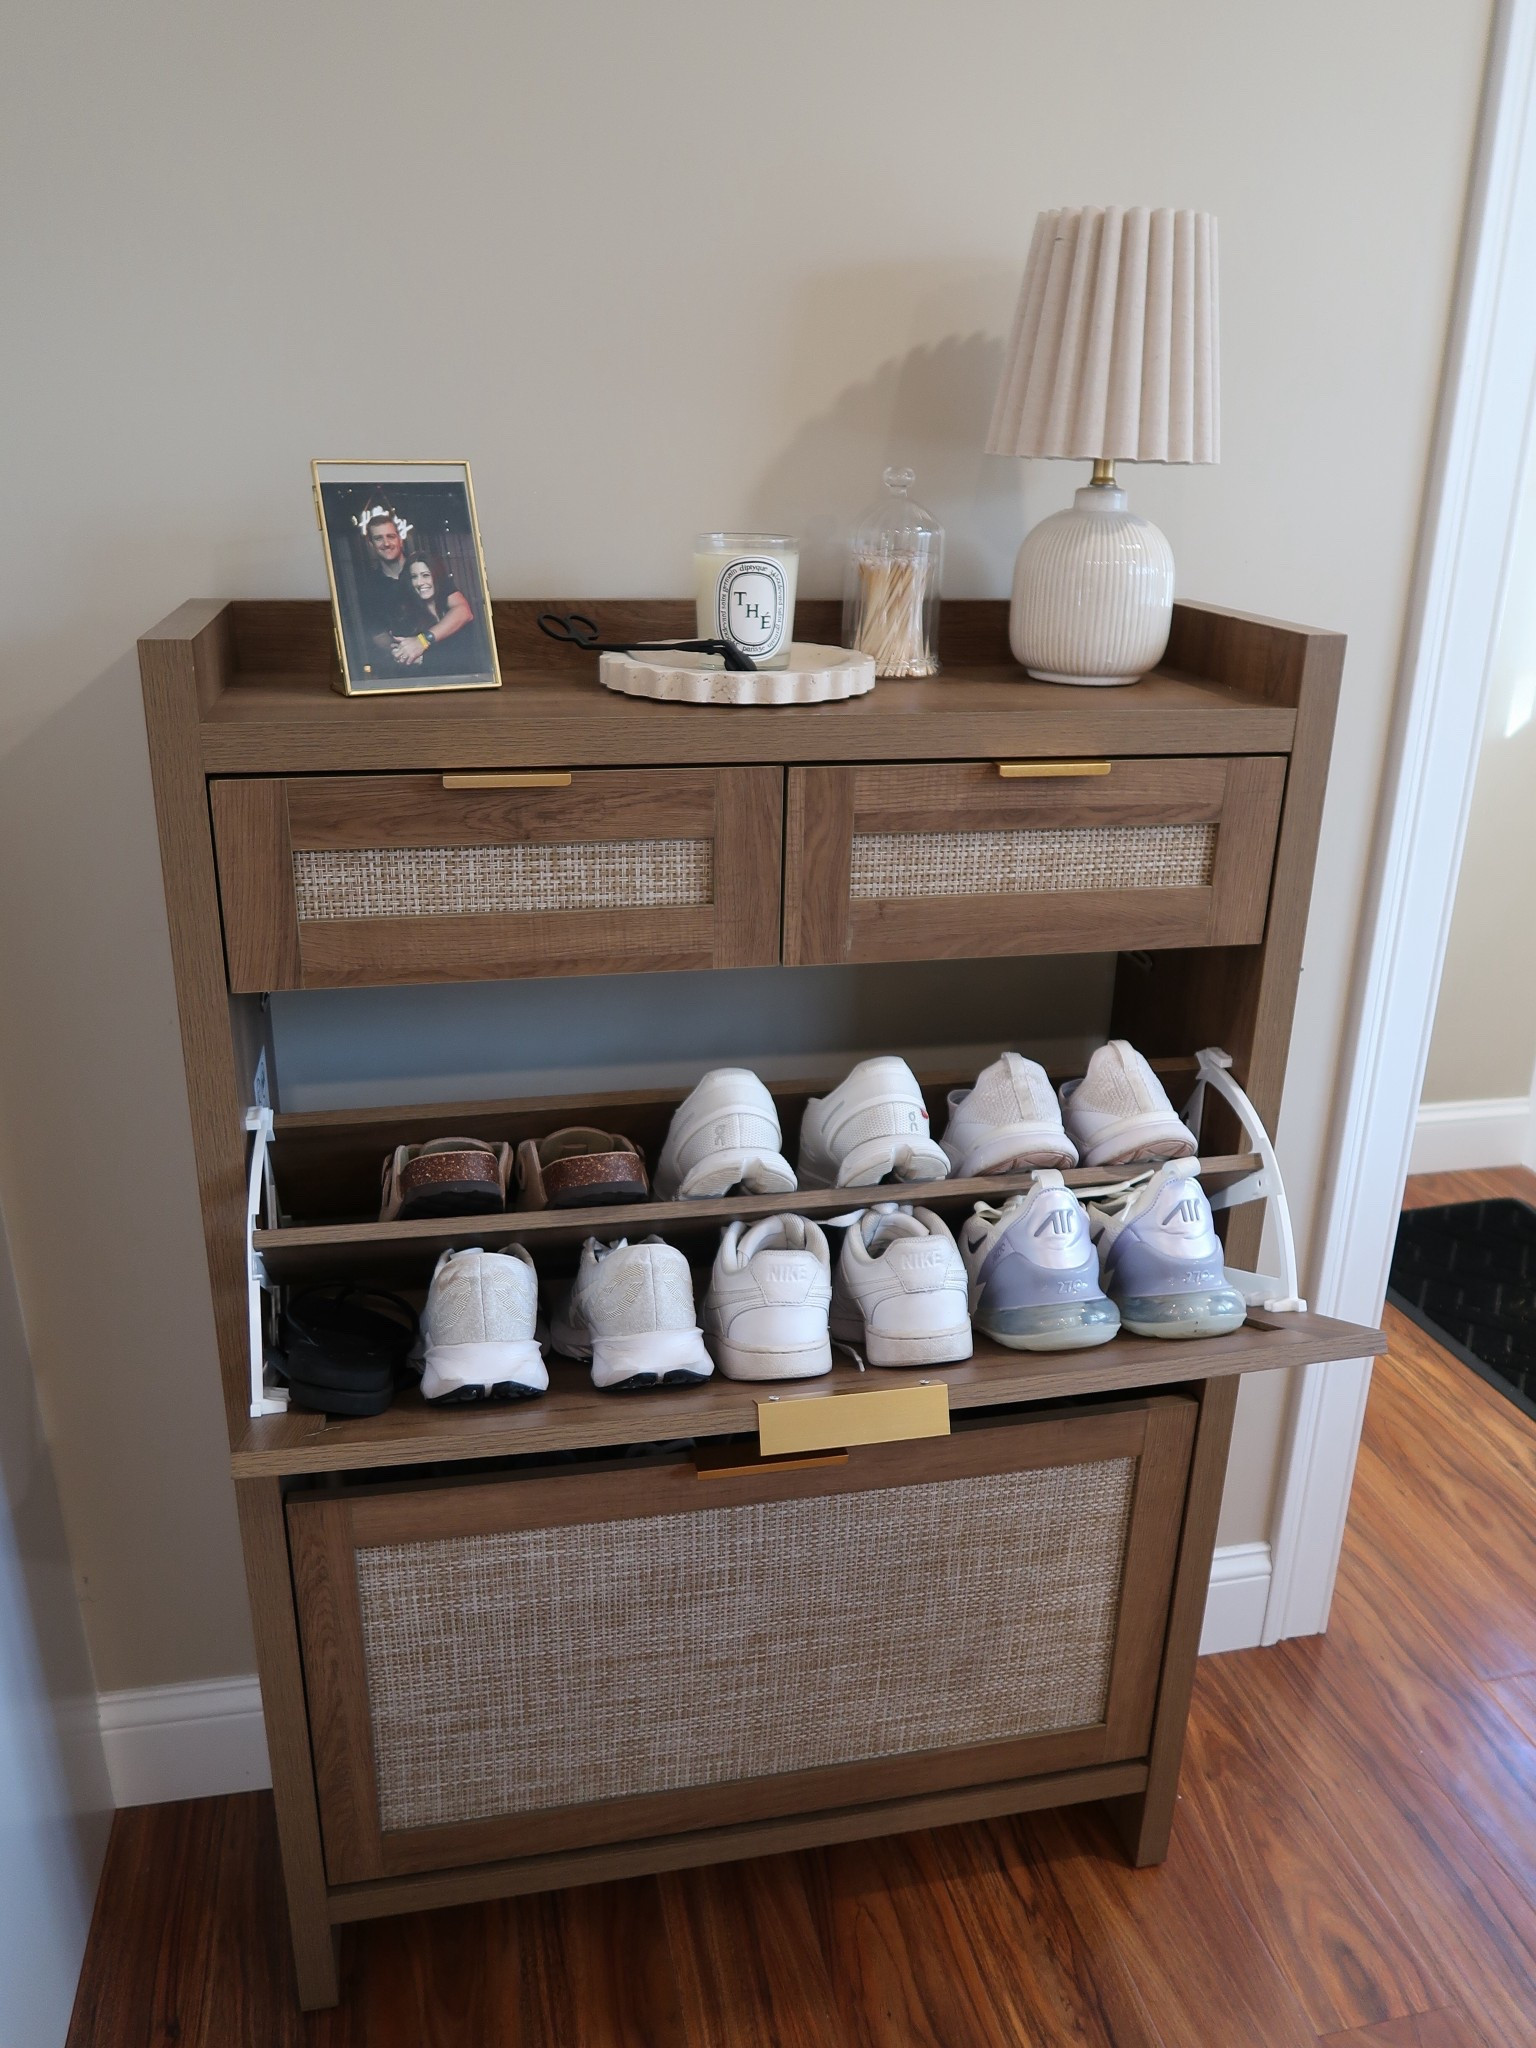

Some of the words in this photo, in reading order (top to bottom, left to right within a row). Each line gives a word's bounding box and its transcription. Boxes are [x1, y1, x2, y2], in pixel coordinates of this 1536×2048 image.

[740, 564, 768, 572] diptyque
[901, 1249, 945, 1270] NIKE
[766, 1263, 810, 1282] NIKE
